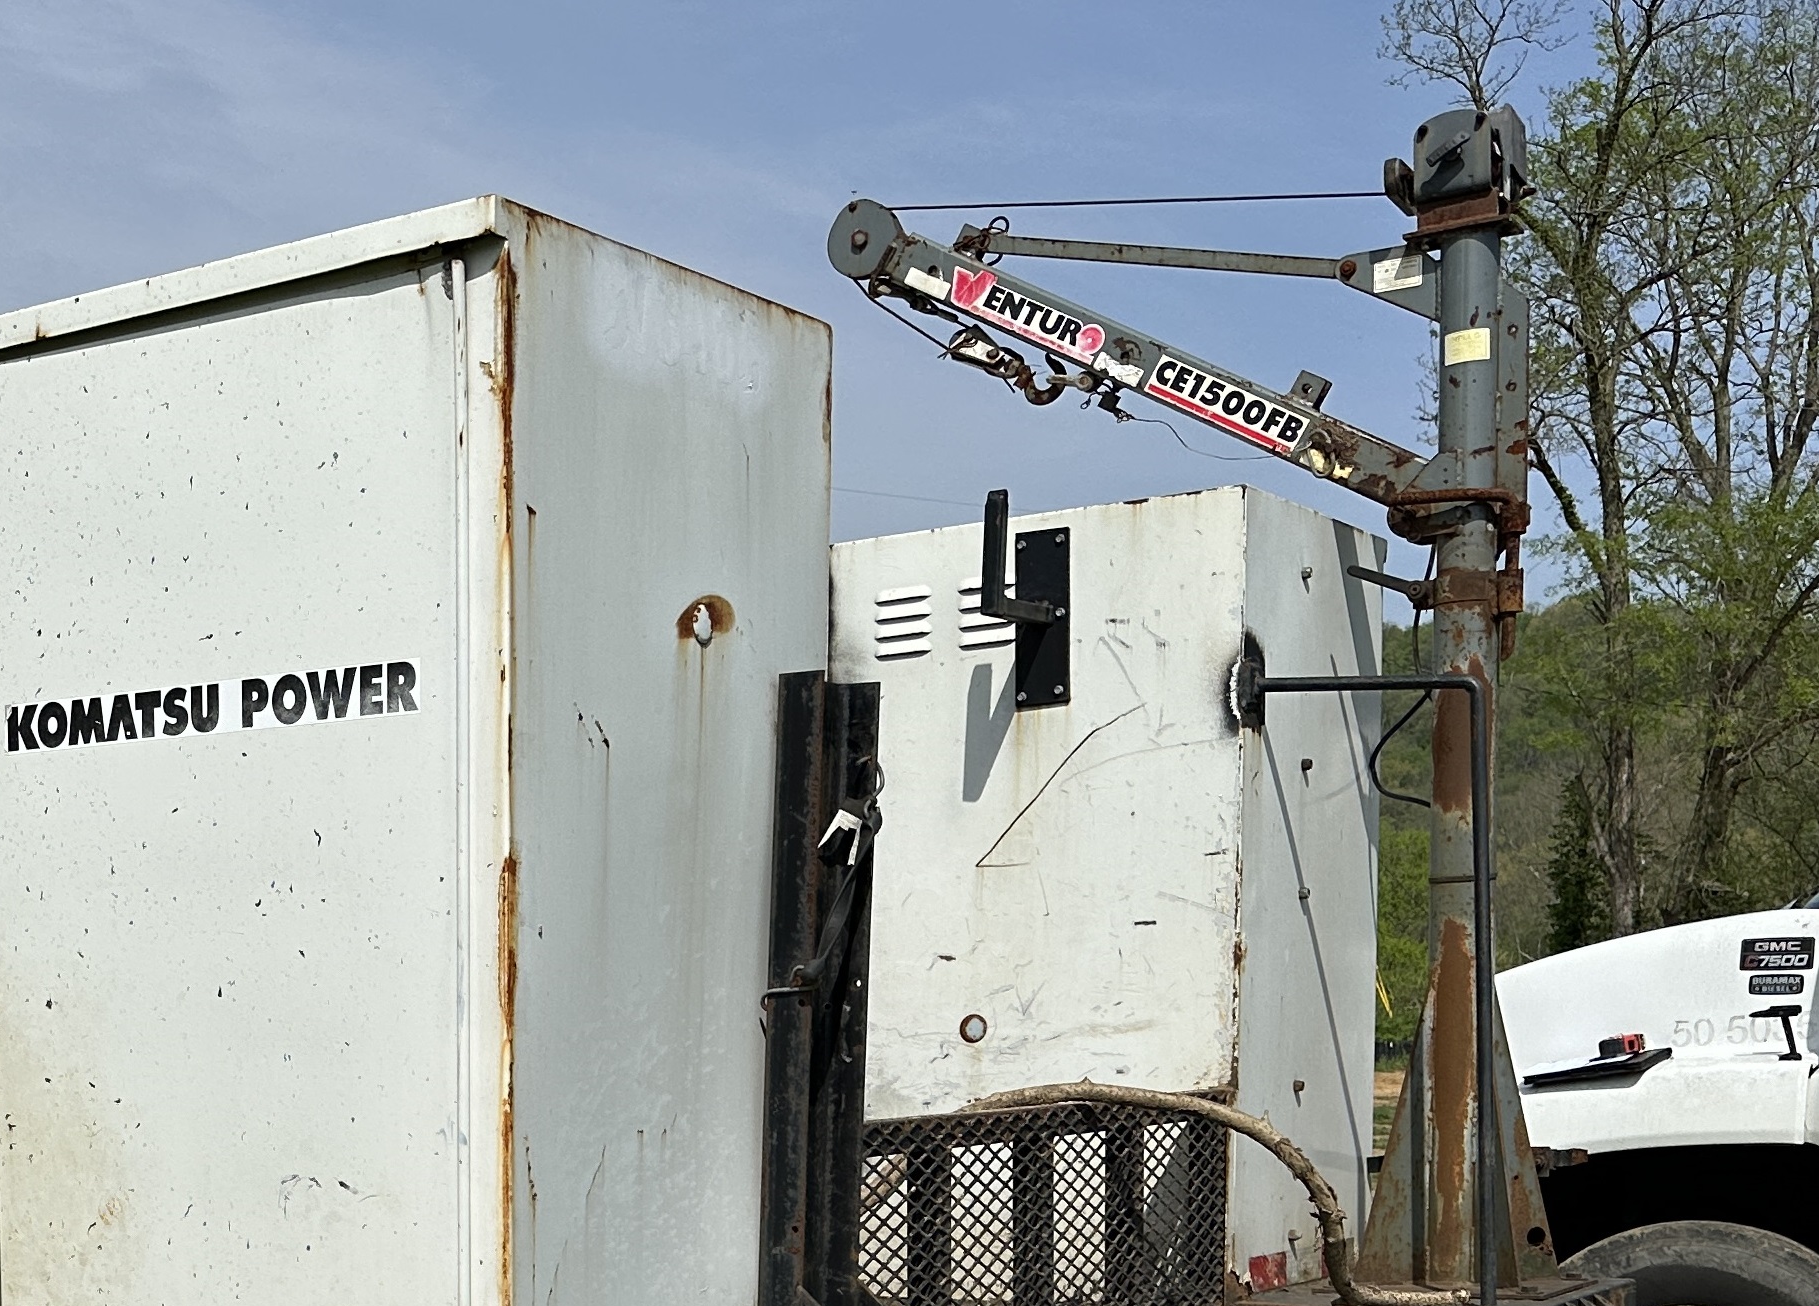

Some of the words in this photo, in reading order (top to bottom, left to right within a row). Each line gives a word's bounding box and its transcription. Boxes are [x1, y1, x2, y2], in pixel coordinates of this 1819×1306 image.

[952, 267, 1105, 354] VENTURO
[1155, 360, 1304, 443] CE1500FB
[7, 682, 220, 752] KOMATSU
[241, 660, 419, 729] POWER
[1743, 953, 1810, 968] C7500
[1754, 941, 1802, 952] GMC
[1751, 976, 1802, 985] DURAMAX
[1670, 1018, 1715, 1048] 50
